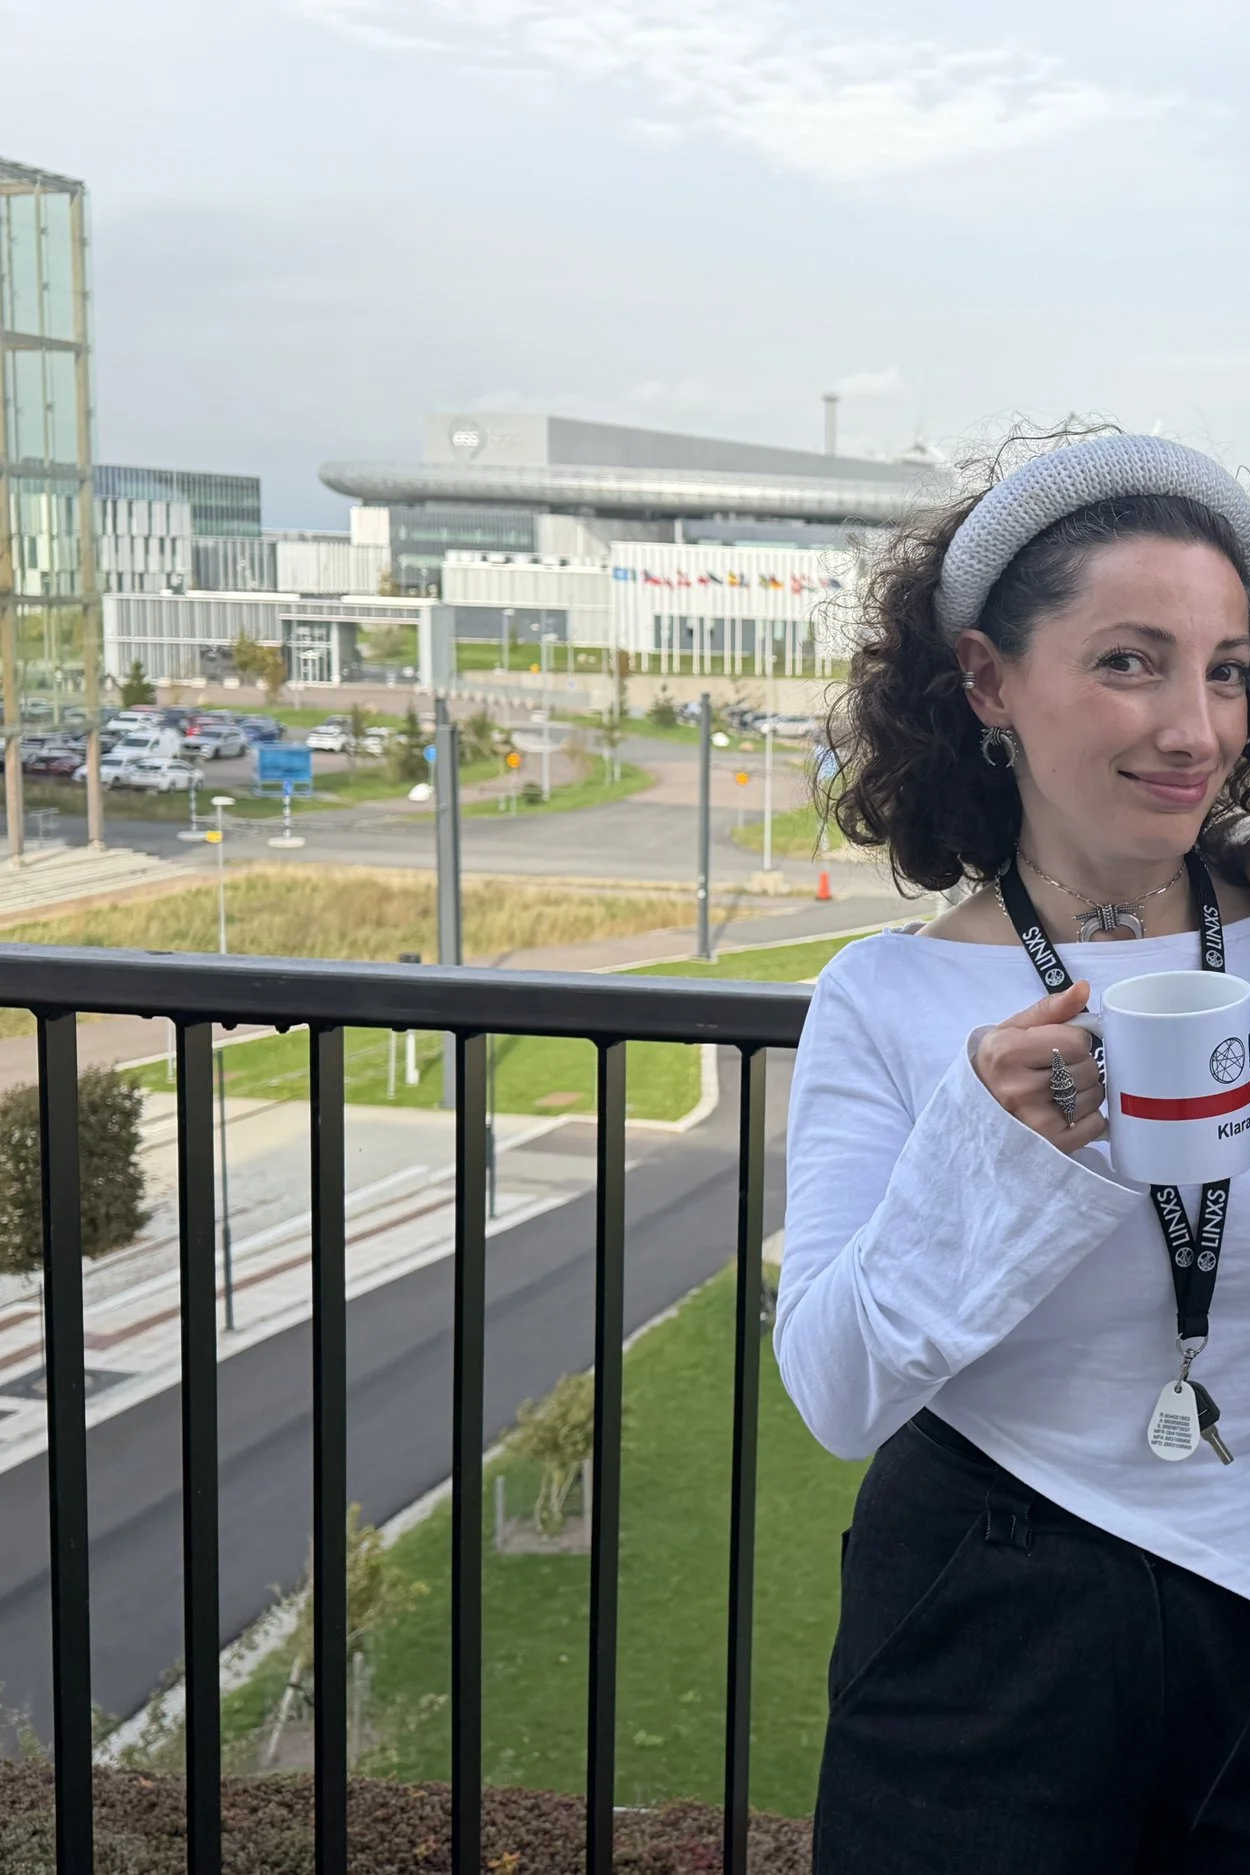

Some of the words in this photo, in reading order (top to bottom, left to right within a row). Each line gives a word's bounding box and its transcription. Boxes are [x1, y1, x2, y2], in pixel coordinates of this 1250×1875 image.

[1021, 926, 1057, 971] LINXS
[1202, 904, 1223, 950] LINXS
[1217, 1117, 1250, 1140] Klara
[1157, 1187, 1190, 1247] LINXS
[1201, 1188, 1226, 1248] LINXS
